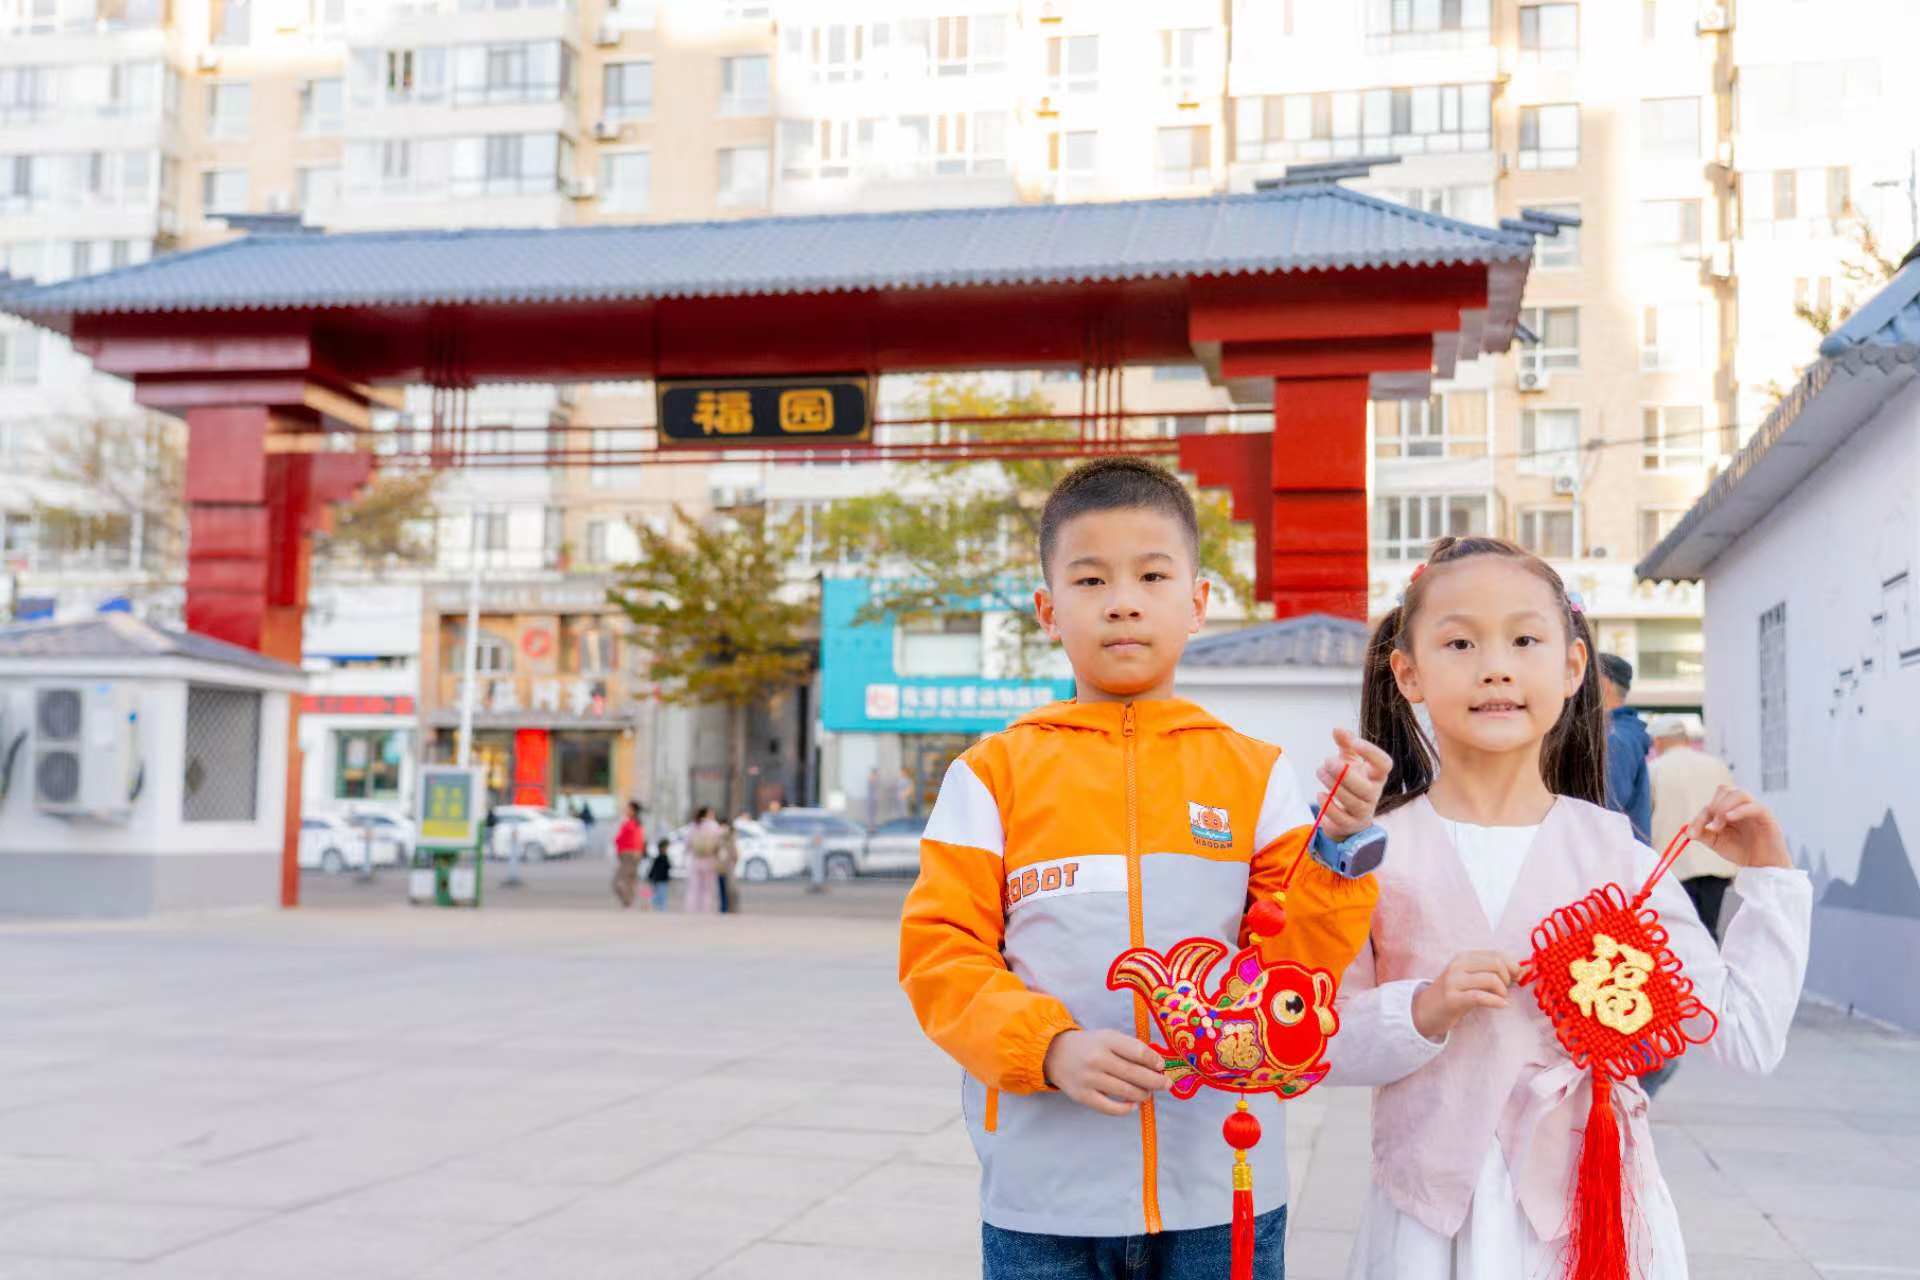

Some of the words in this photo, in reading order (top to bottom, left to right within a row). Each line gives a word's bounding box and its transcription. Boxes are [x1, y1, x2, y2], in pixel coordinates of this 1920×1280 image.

[692, 389, 834, 434] 福园
[1006, 863, 1079, 907] OBOT
[1568, 932, 1656, 1036] 福
[1216, 1022, 1261, 1069] 福
